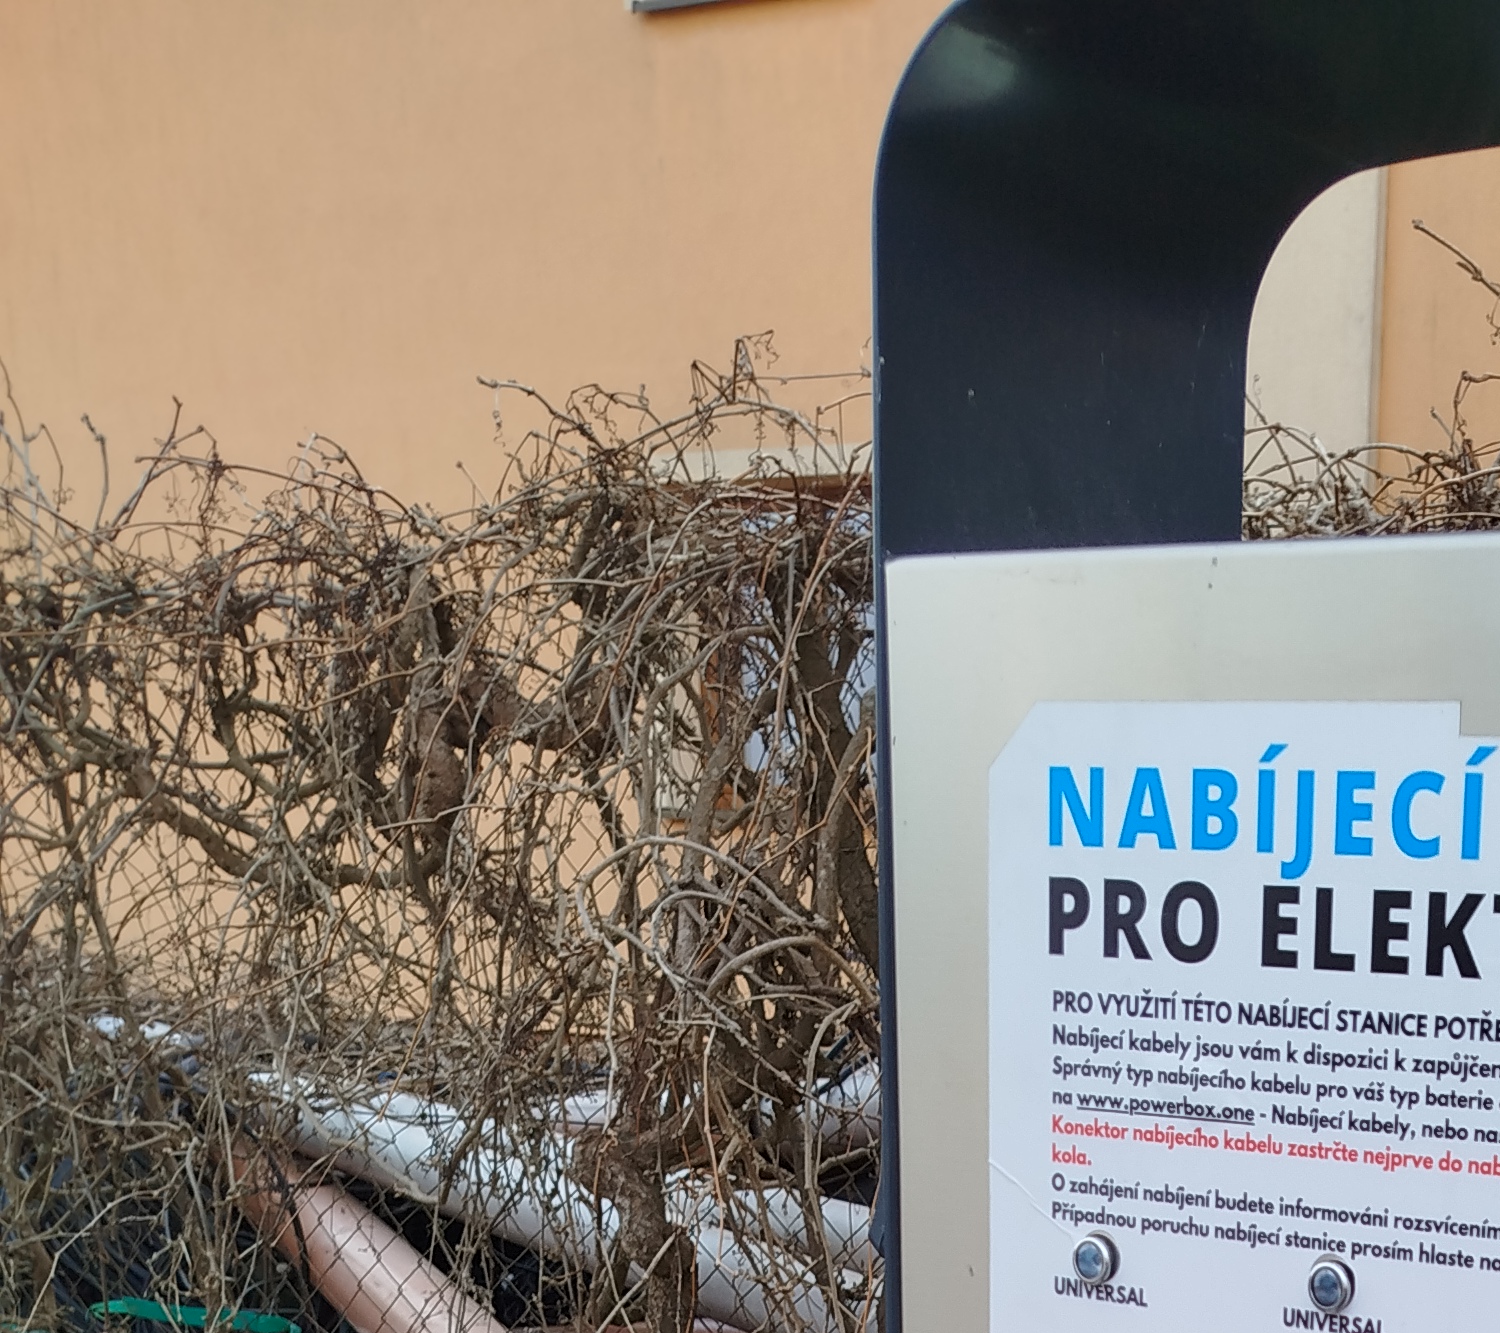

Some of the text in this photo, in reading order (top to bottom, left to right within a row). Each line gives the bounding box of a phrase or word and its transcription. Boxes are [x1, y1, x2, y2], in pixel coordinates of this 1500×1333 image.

[1048, 743, 1498, 880] NABÍJECÍ
[1048, 876, 1220, 965] PRO
[1053, 990, 1093, 1014] PRO
[1097, 988, 1177, 1020] VYUŽITÍ
[1182, 992, 1232, 1024] TÉTO
[1238, 998, 1331, 1030] NABÍJECÍ
[1336, 1009, 1428, 1037] STANICE
[1053, 1024, 1125, 1054] Nabíjecí
[1129, 1029, 1191, 1060] kabely
[1193, 1035, 1233, 1062] jsou
[1238, 1040, 1280, 1062] vám
[1287, 1040, 1298, 1063] k
[1303, 1042, 1388, 1072] dispozici
[1394, 1048, 1407, 1072] k
[1053, 1056, 1122, 1084] Správný
[1126, 1064, 1153, 1087] typ
[1158, 1065, 1246, 1092] nabíjecího
[1251, 1071, 1311, 1095] kabelu
[1316, 1084, 1348, 1102] pro
[1352, 1081, 1385, 1102] váš
[1389, 1085, 1420, 1110] typ
[1425, 1085, 1494, 1110] baterie
[1052, 1114, 1128, 1139] Konektor
[1133, 1123, 1219, 1150] nabíjecího
[1224, 1130, 1283, 1154] kabelu
[1288, 1141, 1358, 1162] zastrčte
[1363, 1146, 1433, 1172] nejprve
[1439, 1150, 1462, 1172] do
[1053, 1092, 1072, 1105] na
[1077, 1093, 1255, 1126] www.powerbox.one
[1272, 1104, 1345, 1133] Nabíjecí
[1348, 1110, 1415, 1141] kabely,
[1422, 1118, 1468, 1140] nebo
[1052, 1143, 1091, 1165] kola.
[1052, 1173, 1065, 1191] O
[1069, 1176, 1140, 1202] zahájení
[1143, 1184, 1212, 1210] nabíjení
[1215, 1189, 1274, 1214] budete
[1279, 1197, 1389, 1227] informováni
[1052, 1201, 1136, 1228] Případnou
[1141, 1216, 1209, 1237] poruchu
[1215, 1221, 1282, 1248] nabíjecí
[1285, 1231, 1346, 1253] stanice
[1351, 1240, 1413, 1262] prosím
[1419, 1242, 1474, 1268] hlaste
[1054, 1276, 1148, 1307] UNIVERSAL
